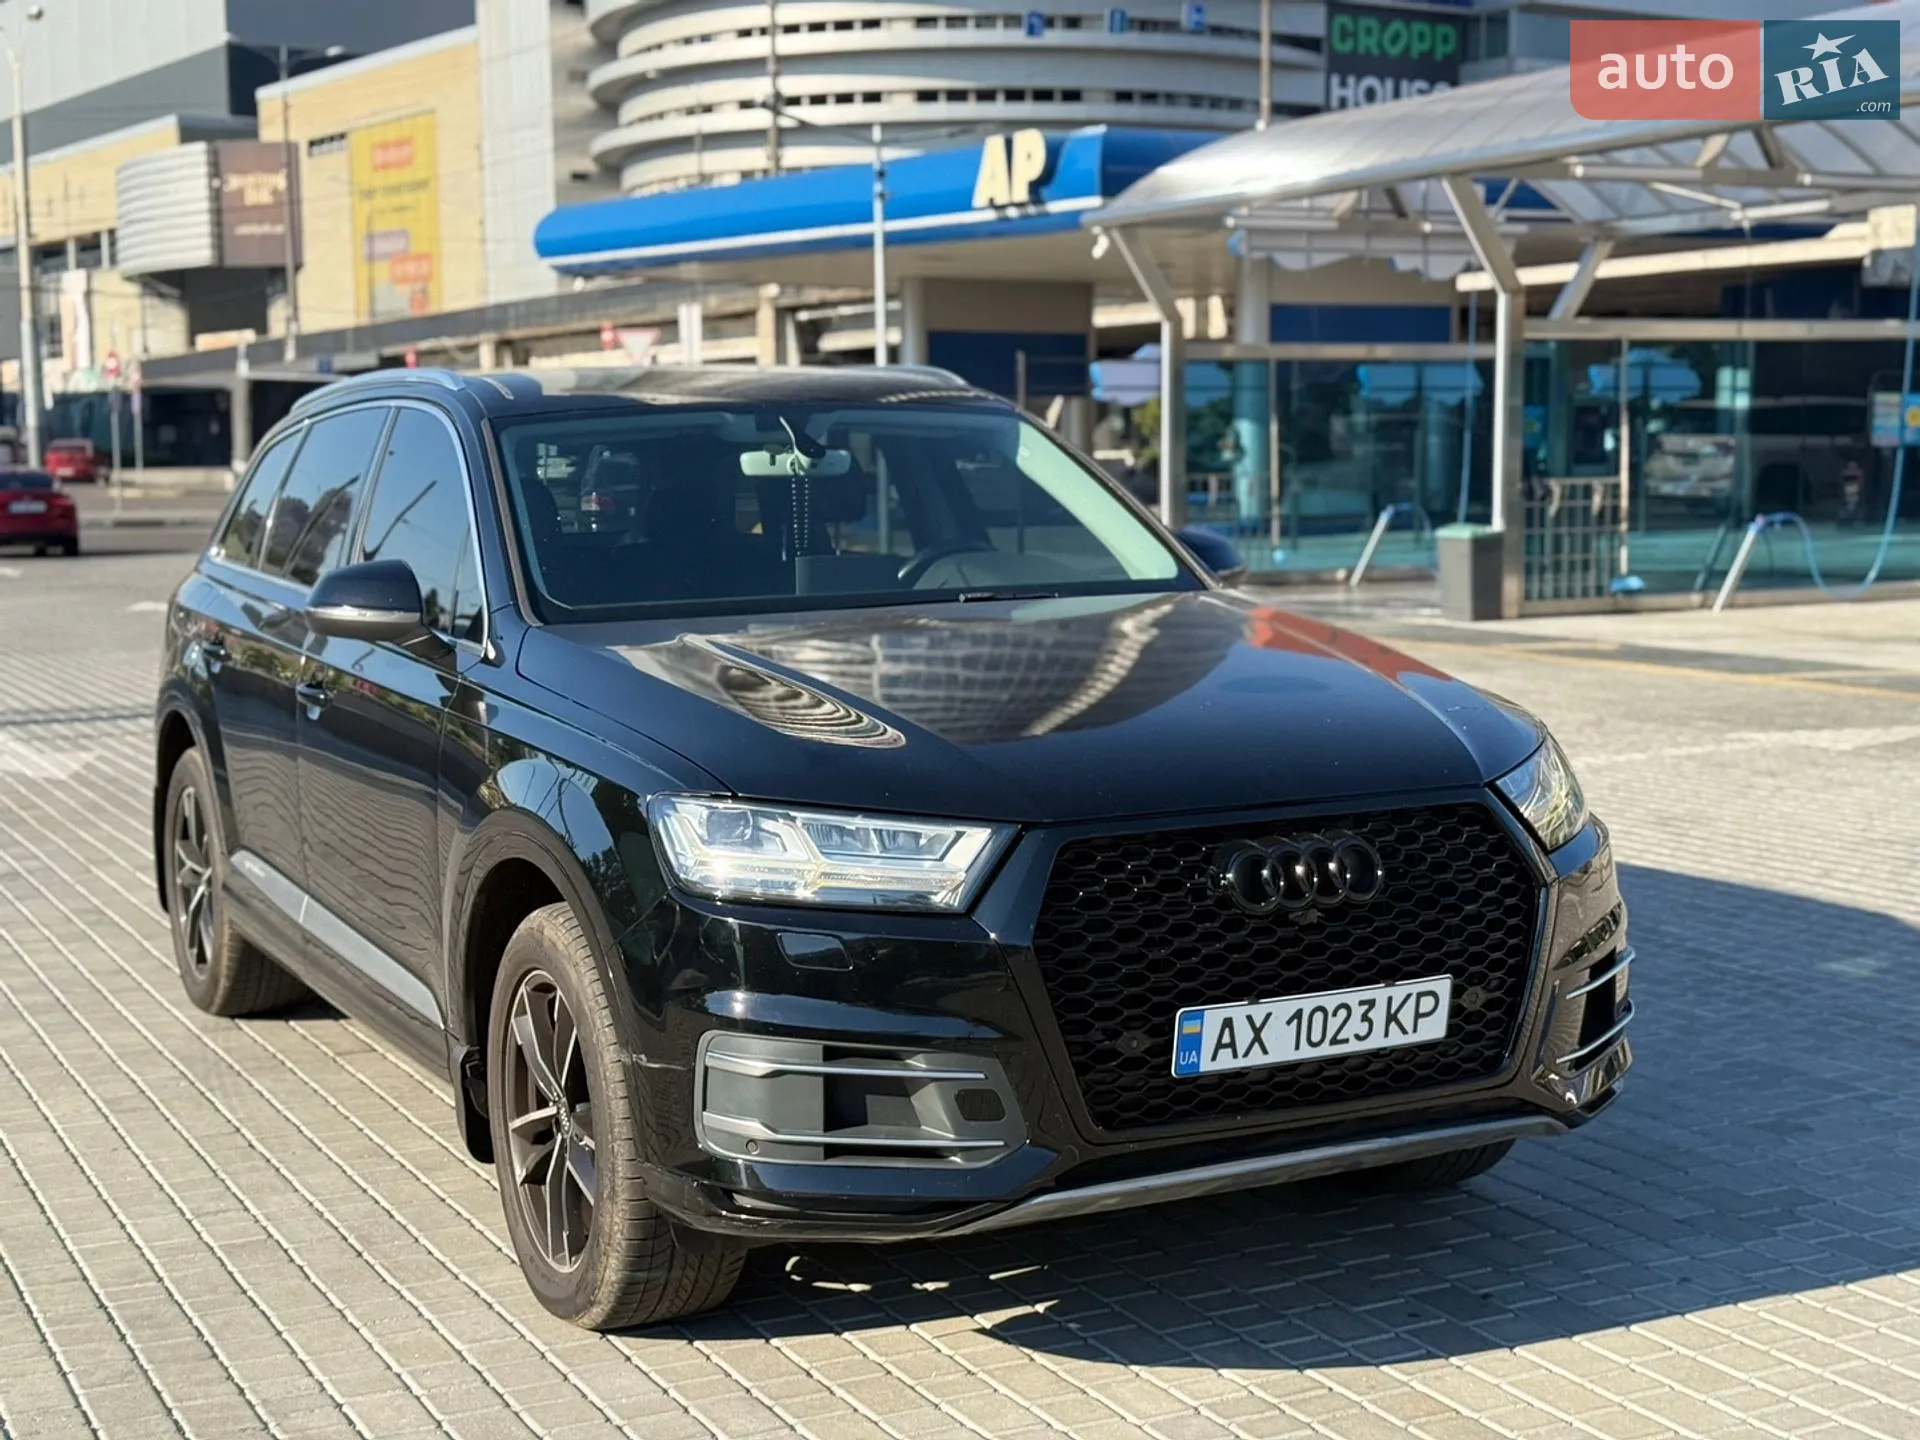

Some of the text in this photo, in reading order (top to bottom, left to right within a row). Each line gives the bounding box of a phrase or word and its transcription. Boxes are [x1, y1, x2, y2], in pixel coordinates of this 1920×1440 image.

[1331, 13, 1458, 62] CROPP
[1329, 72, 1452, 109] HOUS
[1210, 990, 1440, 1062] AX 1023 KP
[1179, 1050, 1199, 1066] UA
